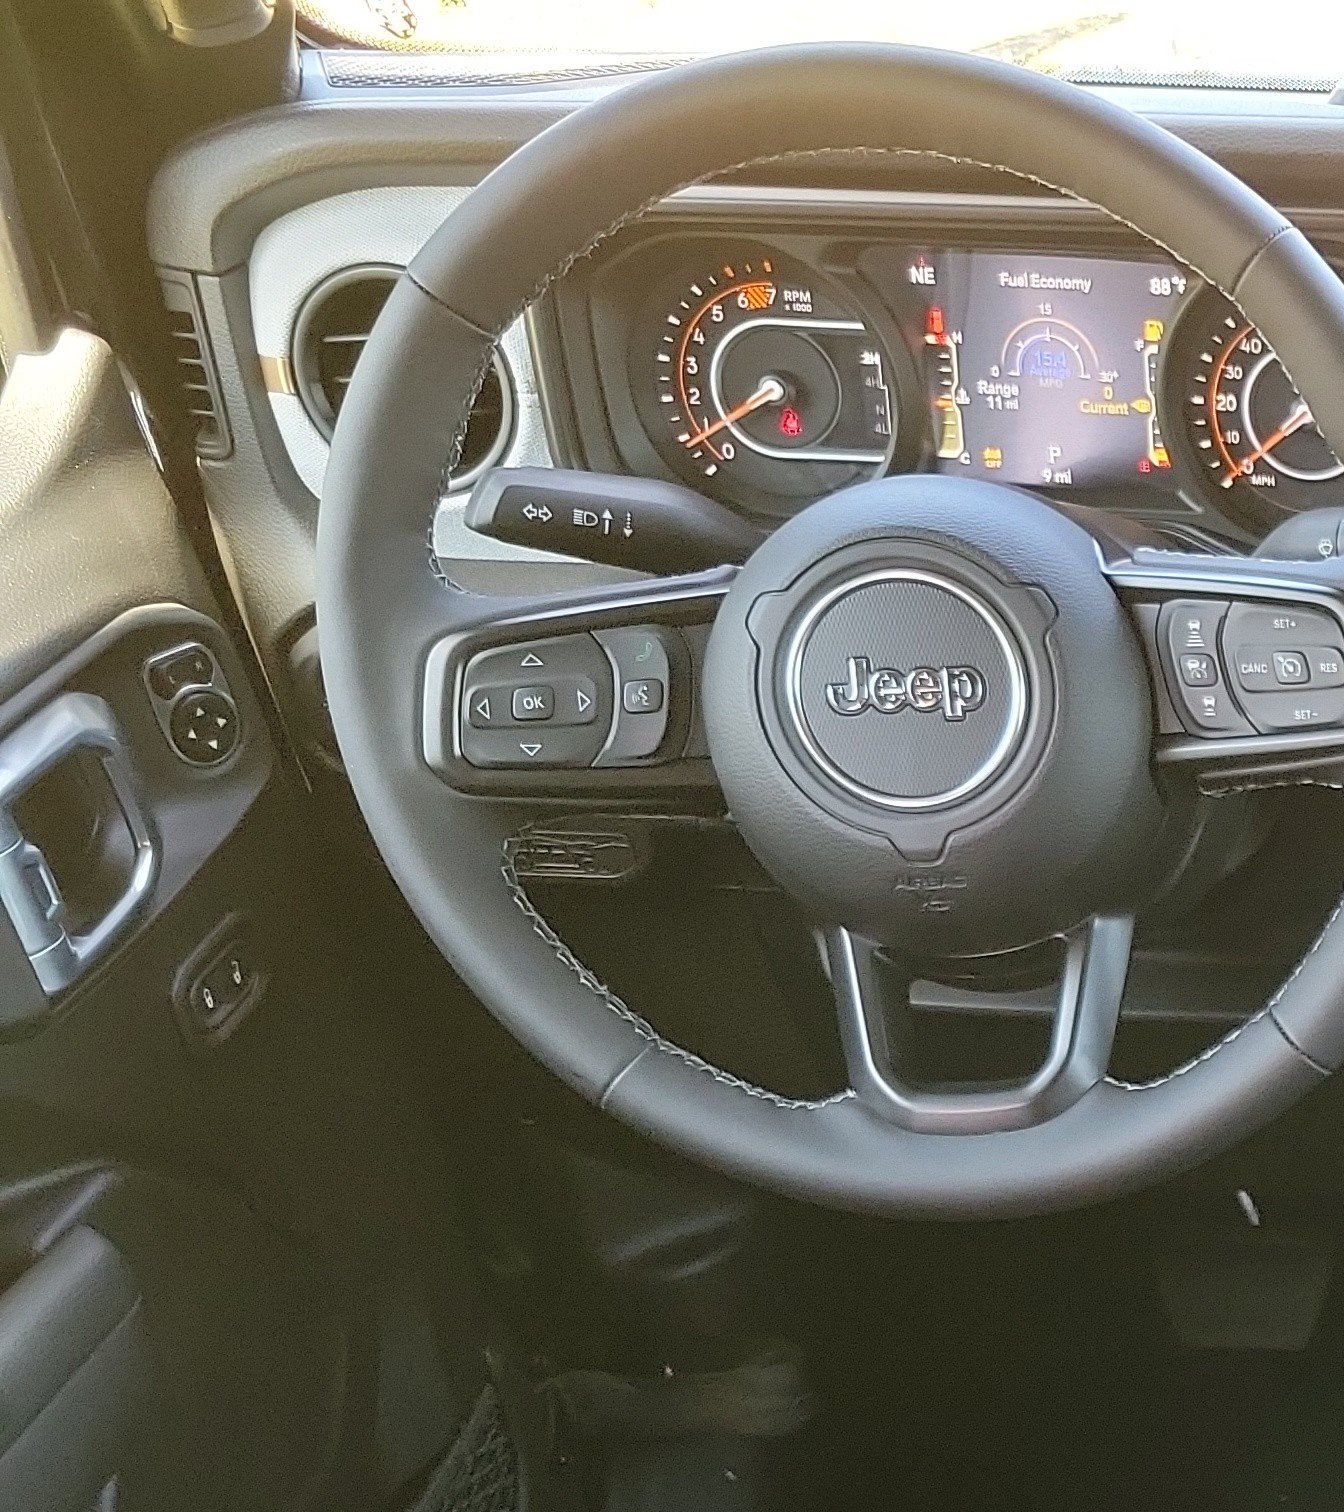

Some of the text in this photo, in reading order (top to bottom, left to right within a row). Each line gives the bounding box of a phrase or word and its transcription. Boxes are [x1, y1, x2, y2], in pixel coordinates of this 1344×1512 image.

[909, 267, 936, 285] NE
[1000, 272, 1092, 293] Fuel Economy
[738, 289, 777, 308] 6 7
[784, 290, 811, 303] RPM
[712, 306, 724, 322] 5
[1039, 303, 1053, 316] 15
[693, 331, 705, 346] 4
[1240, 338, 1262, 353] 40
[687, 357, 698, 373] 3
[990, 366, 1000, 378] 0
[1225, 365, 1243, 380] 30
[977, 379, 1020, 397] Range
[689, 388, 701, 405] 2
[986, 396, 1003, 411] 11
[1215, 395, 1237, 412] 20
[1080, 400, 1129, 415] Current
[1225, 430, 1240, 444] 10
[722, 444, 735, 460] 0
[1049, 446, 1062, 464] P
[1053, 468, 1073, 485] mi
[1250, 475, 1276, 487] MPH
[1241, 663, 1268, 676] CANC
[1320, 663, 1338, 674] RES
[826, 656, 988, 722] Jeep
[522, 694, 545, 711] OK
